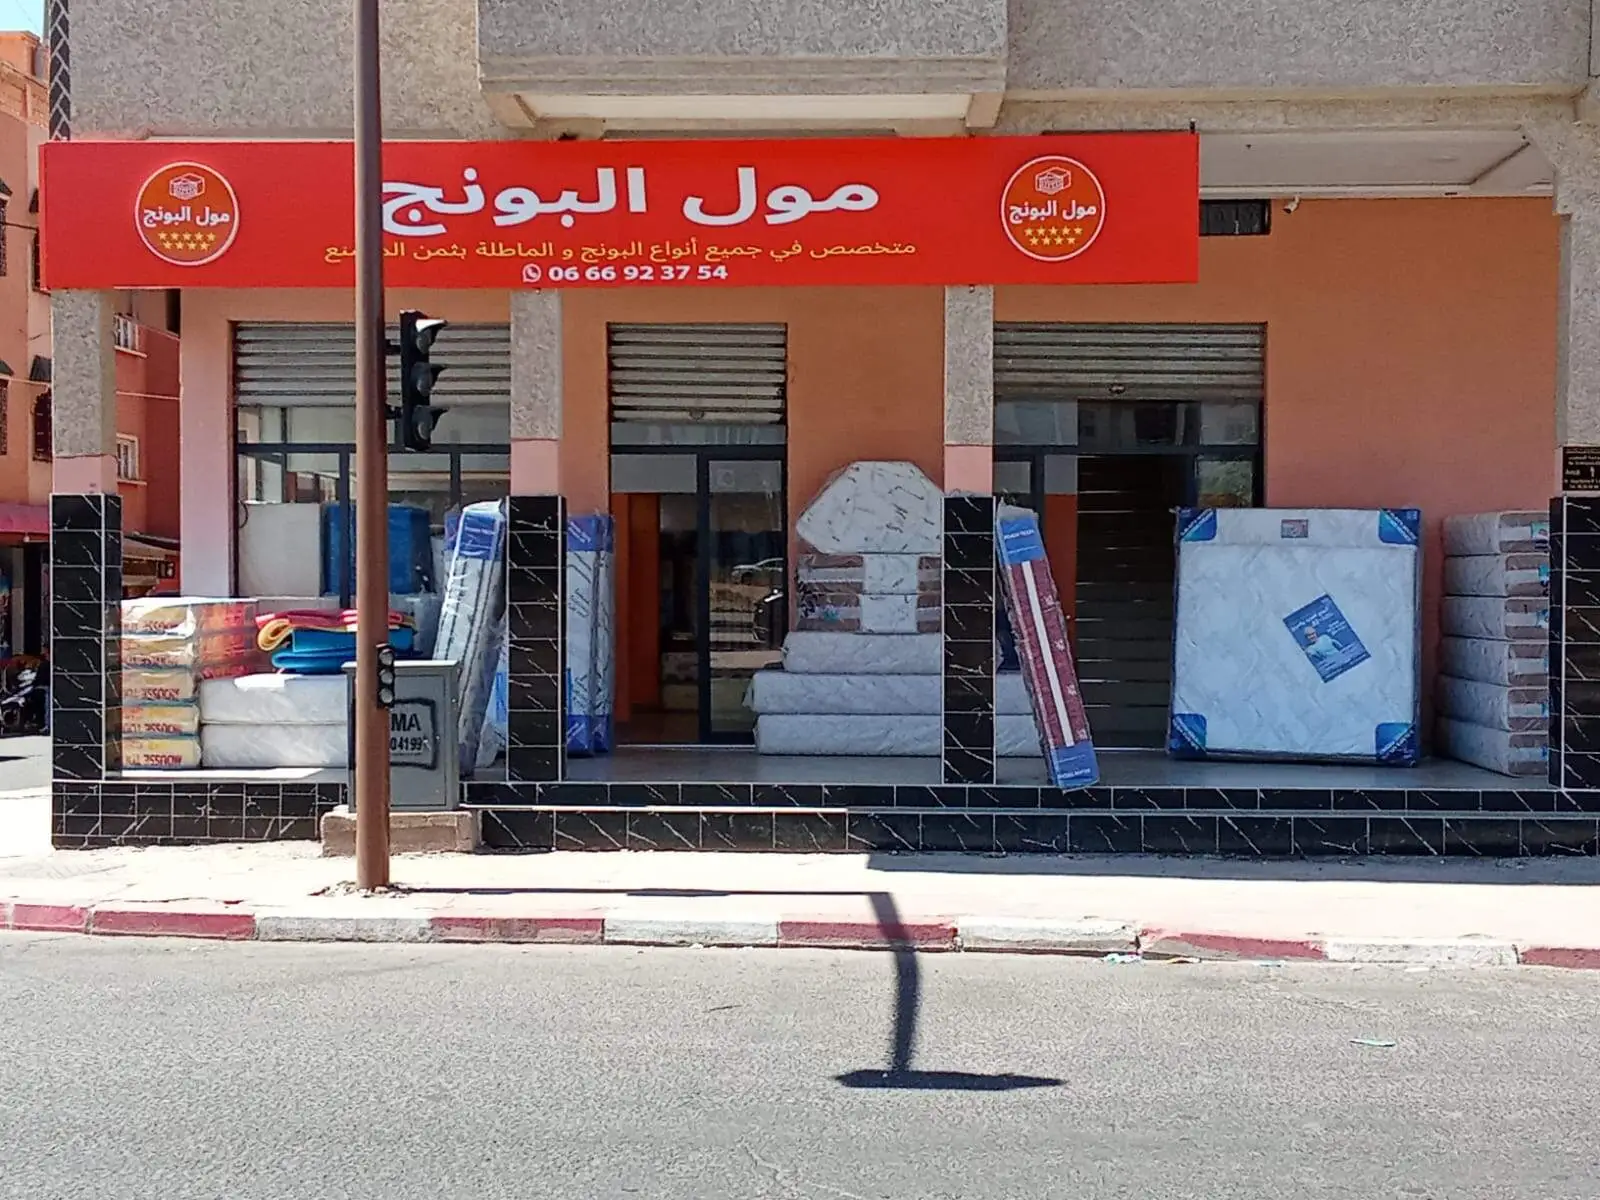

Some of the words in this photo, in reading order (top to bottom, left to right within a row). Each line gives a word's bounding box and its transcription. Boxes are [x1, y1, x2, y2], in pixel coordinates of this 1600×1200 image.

[382, 166, 647, 236] البونج
[683, 166, 879, 226] مول
[143, 205, 191, 228] البونج
[195, 206, 230, 227] مول
[1009, 199, 1057, 225] البونج
[1062, 199, 1097, 221] مول
[412, 243, 468, 261] بثمن
[475, 241, 554, 259] الماطلة
[562, 248, 574, 261] و
[580, 240, 643, 263] البونج
[649, 237, 698, 262] أنواع
[704, 246, 763, 262] جميع
[769, 239, 803, 262] في
[809, 241, 916, 259] متخصص
[548, 266, 581, 282] 06
[585, 266, 616, 281] 66
[622, 266, 654, 281] 92
[660, 265, 691, 280] 37
[697, 265, 729, 280] 54
